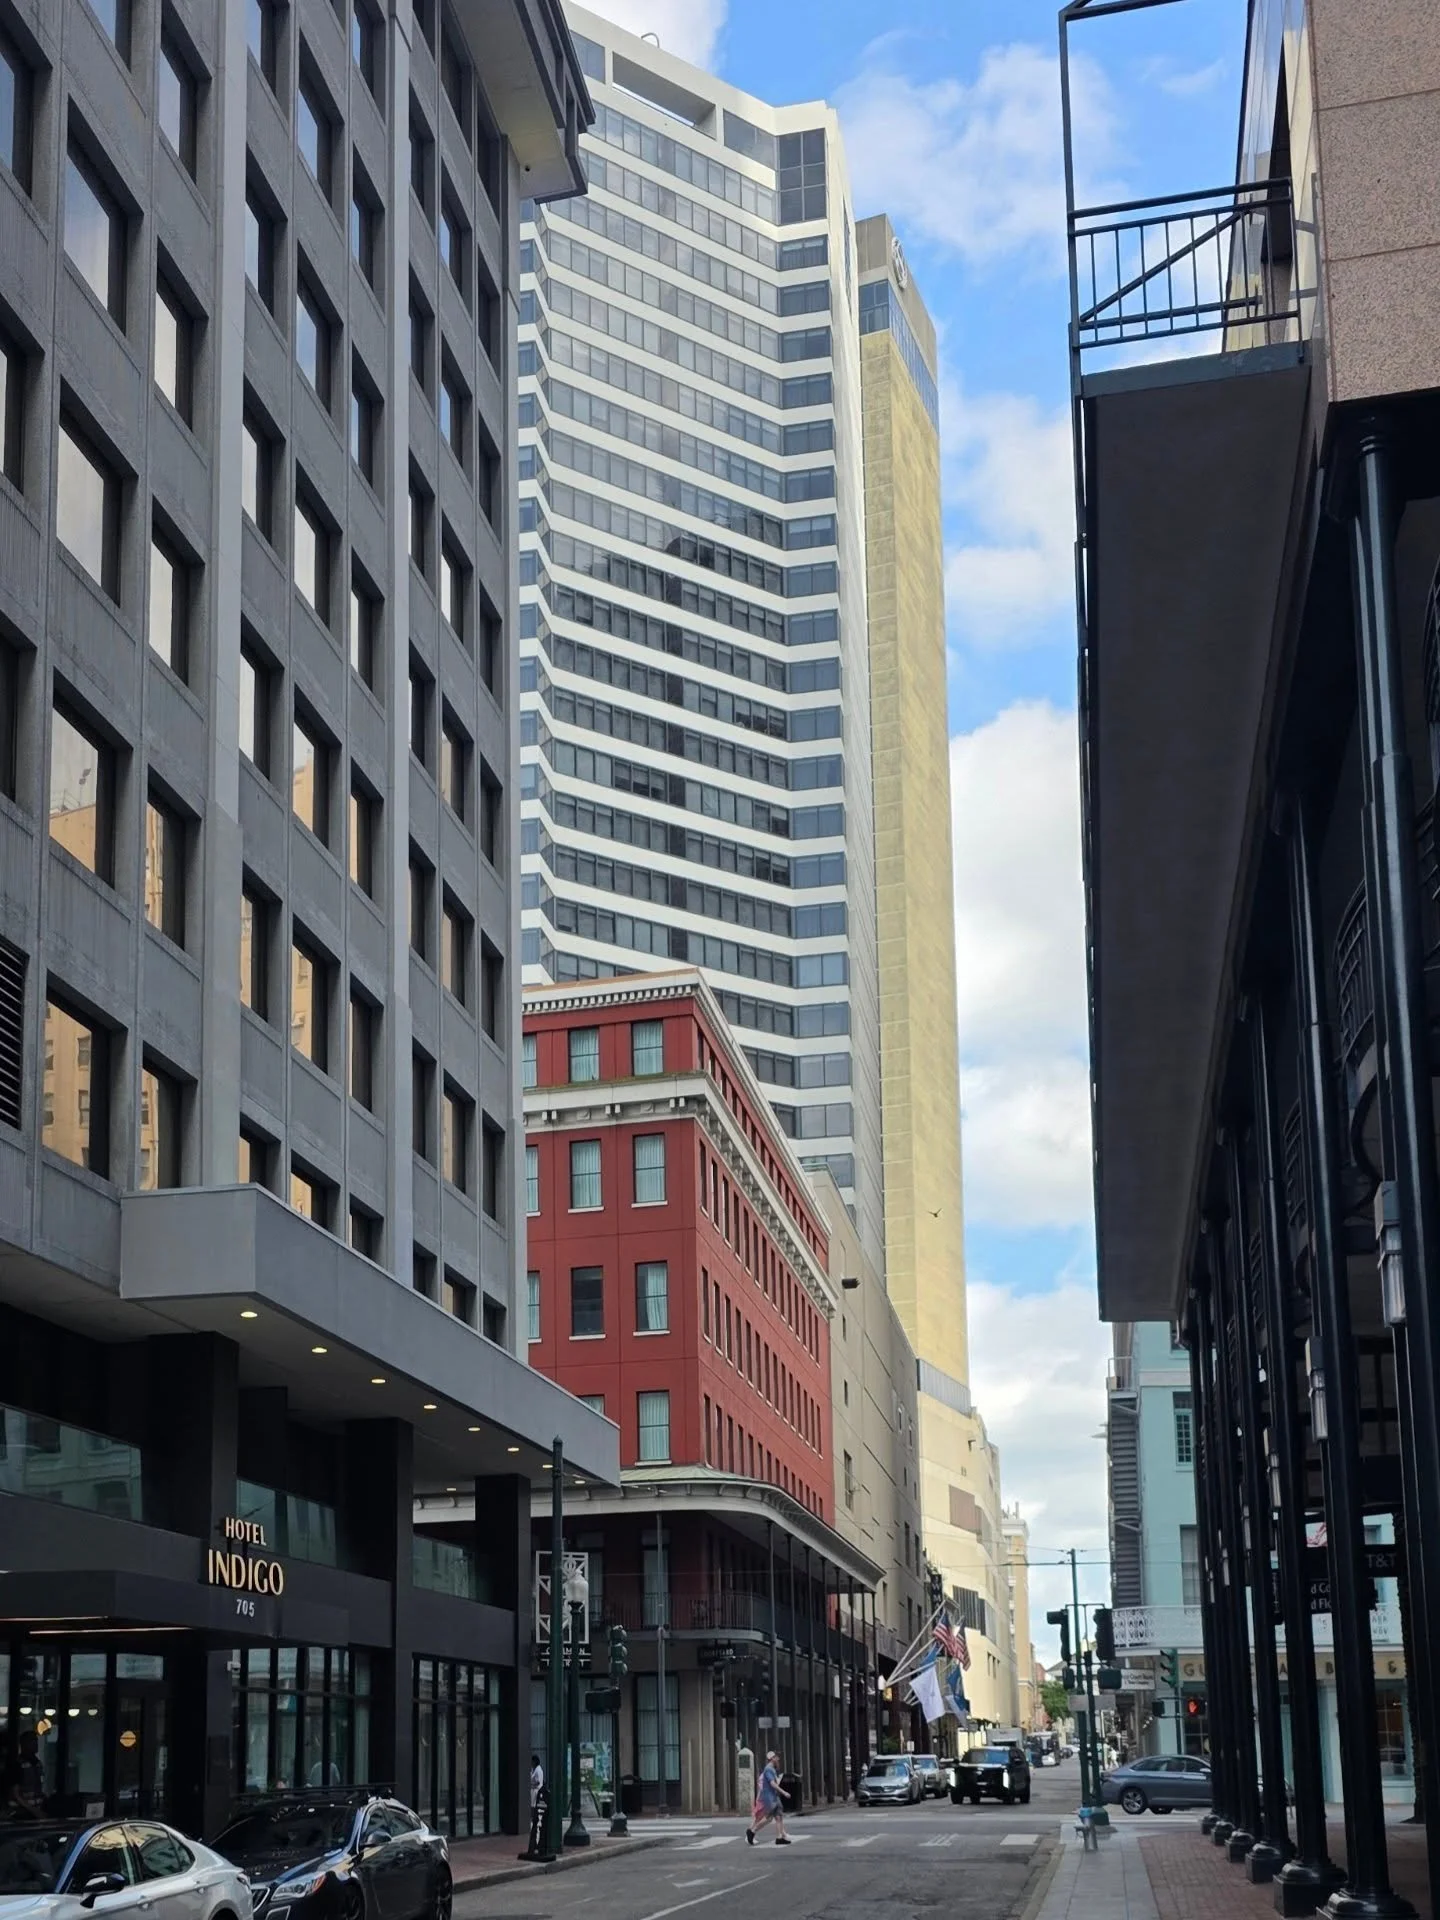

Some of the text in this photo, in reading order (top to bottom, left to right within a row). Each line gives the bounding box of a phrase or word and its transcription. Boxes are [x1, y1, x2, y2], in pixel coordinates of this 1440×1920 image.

[225, 1517, 267, 1546] HOTEL
[208, 1549, 284, 1595] INDIGO
[236, 1599, 255, 1617] 705
